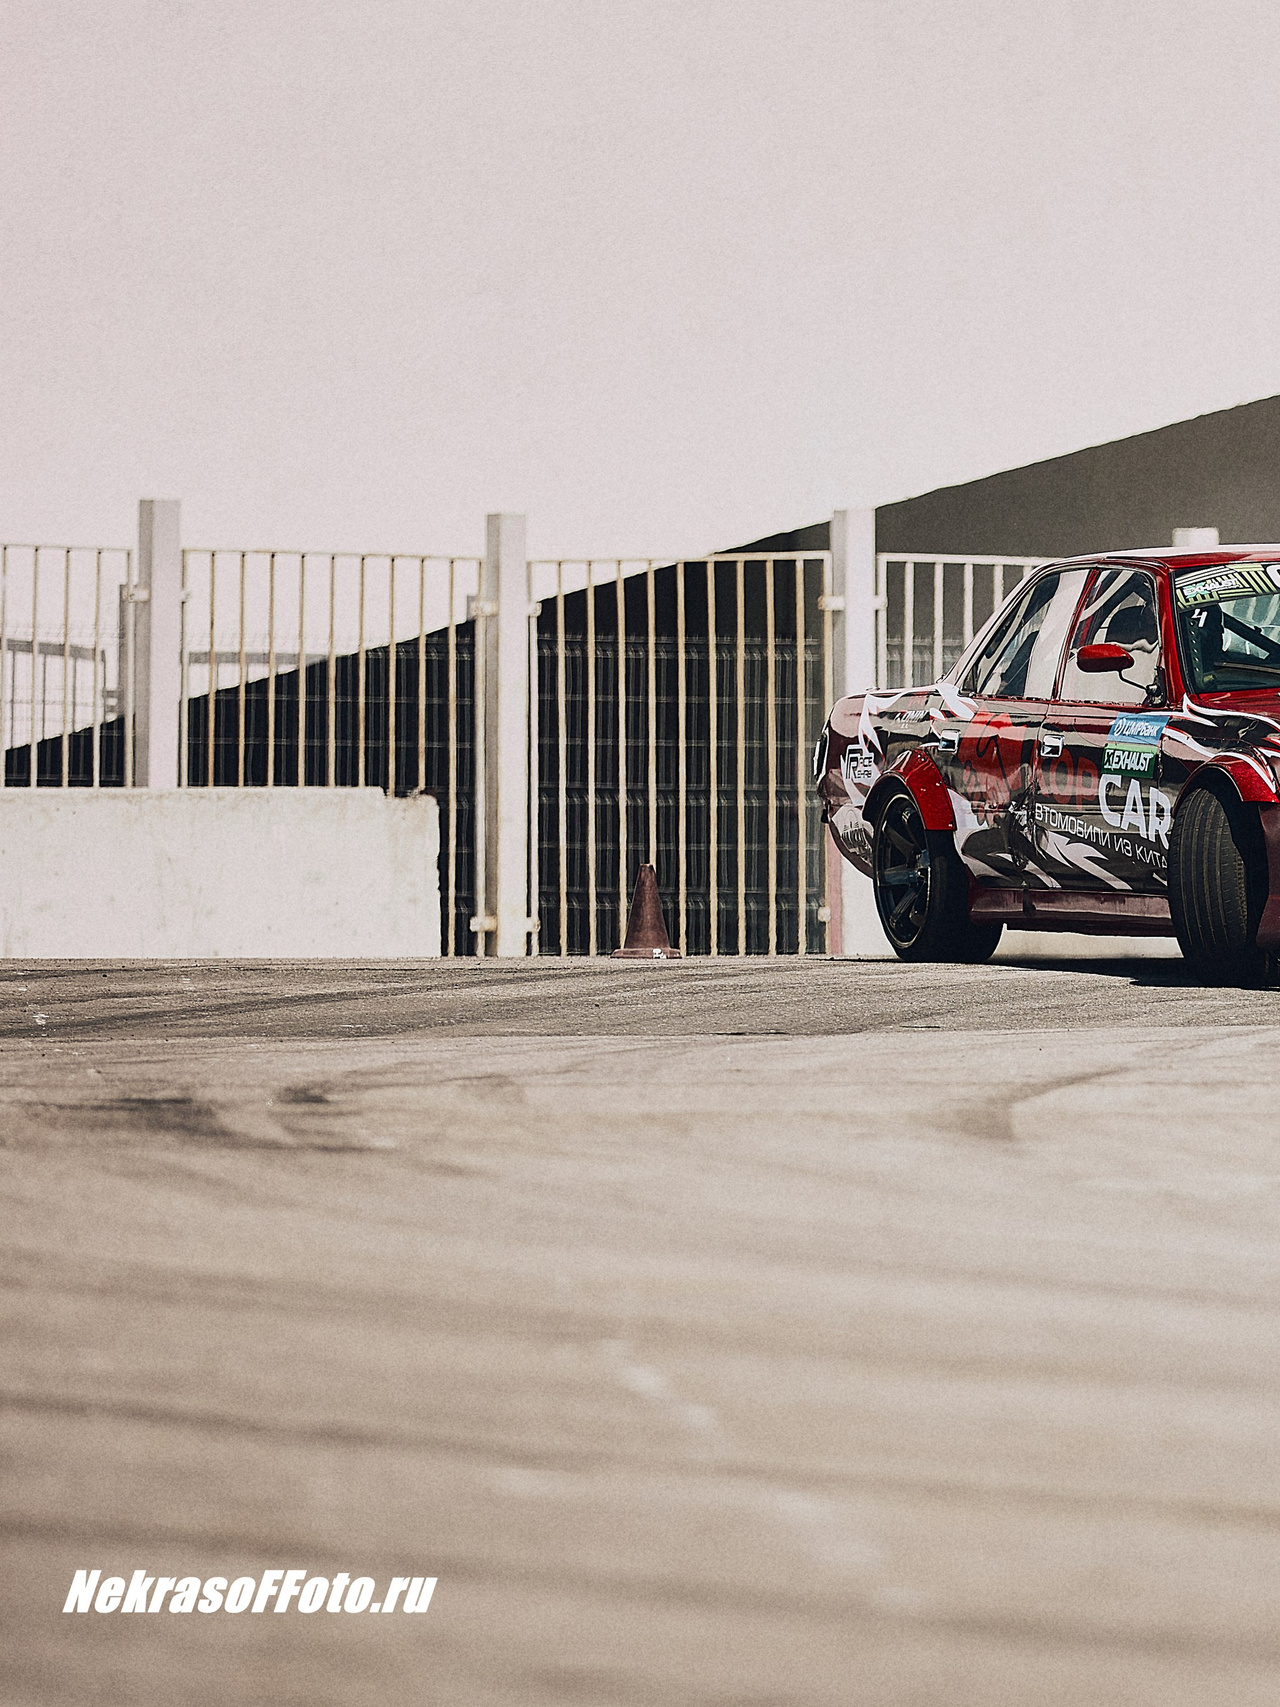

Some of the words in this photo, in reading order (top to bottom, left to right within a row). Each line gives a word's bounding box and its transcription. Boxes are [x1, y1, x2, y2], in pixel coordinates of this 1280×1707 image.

[1191, 608, 1208, 628] 4
[1113, 750, 1154, 771] EXHAUST
[1033, 802, 1111, 848] ВТОМОБИЛИ
[1113, 835, 1133, 857] ИЗ
